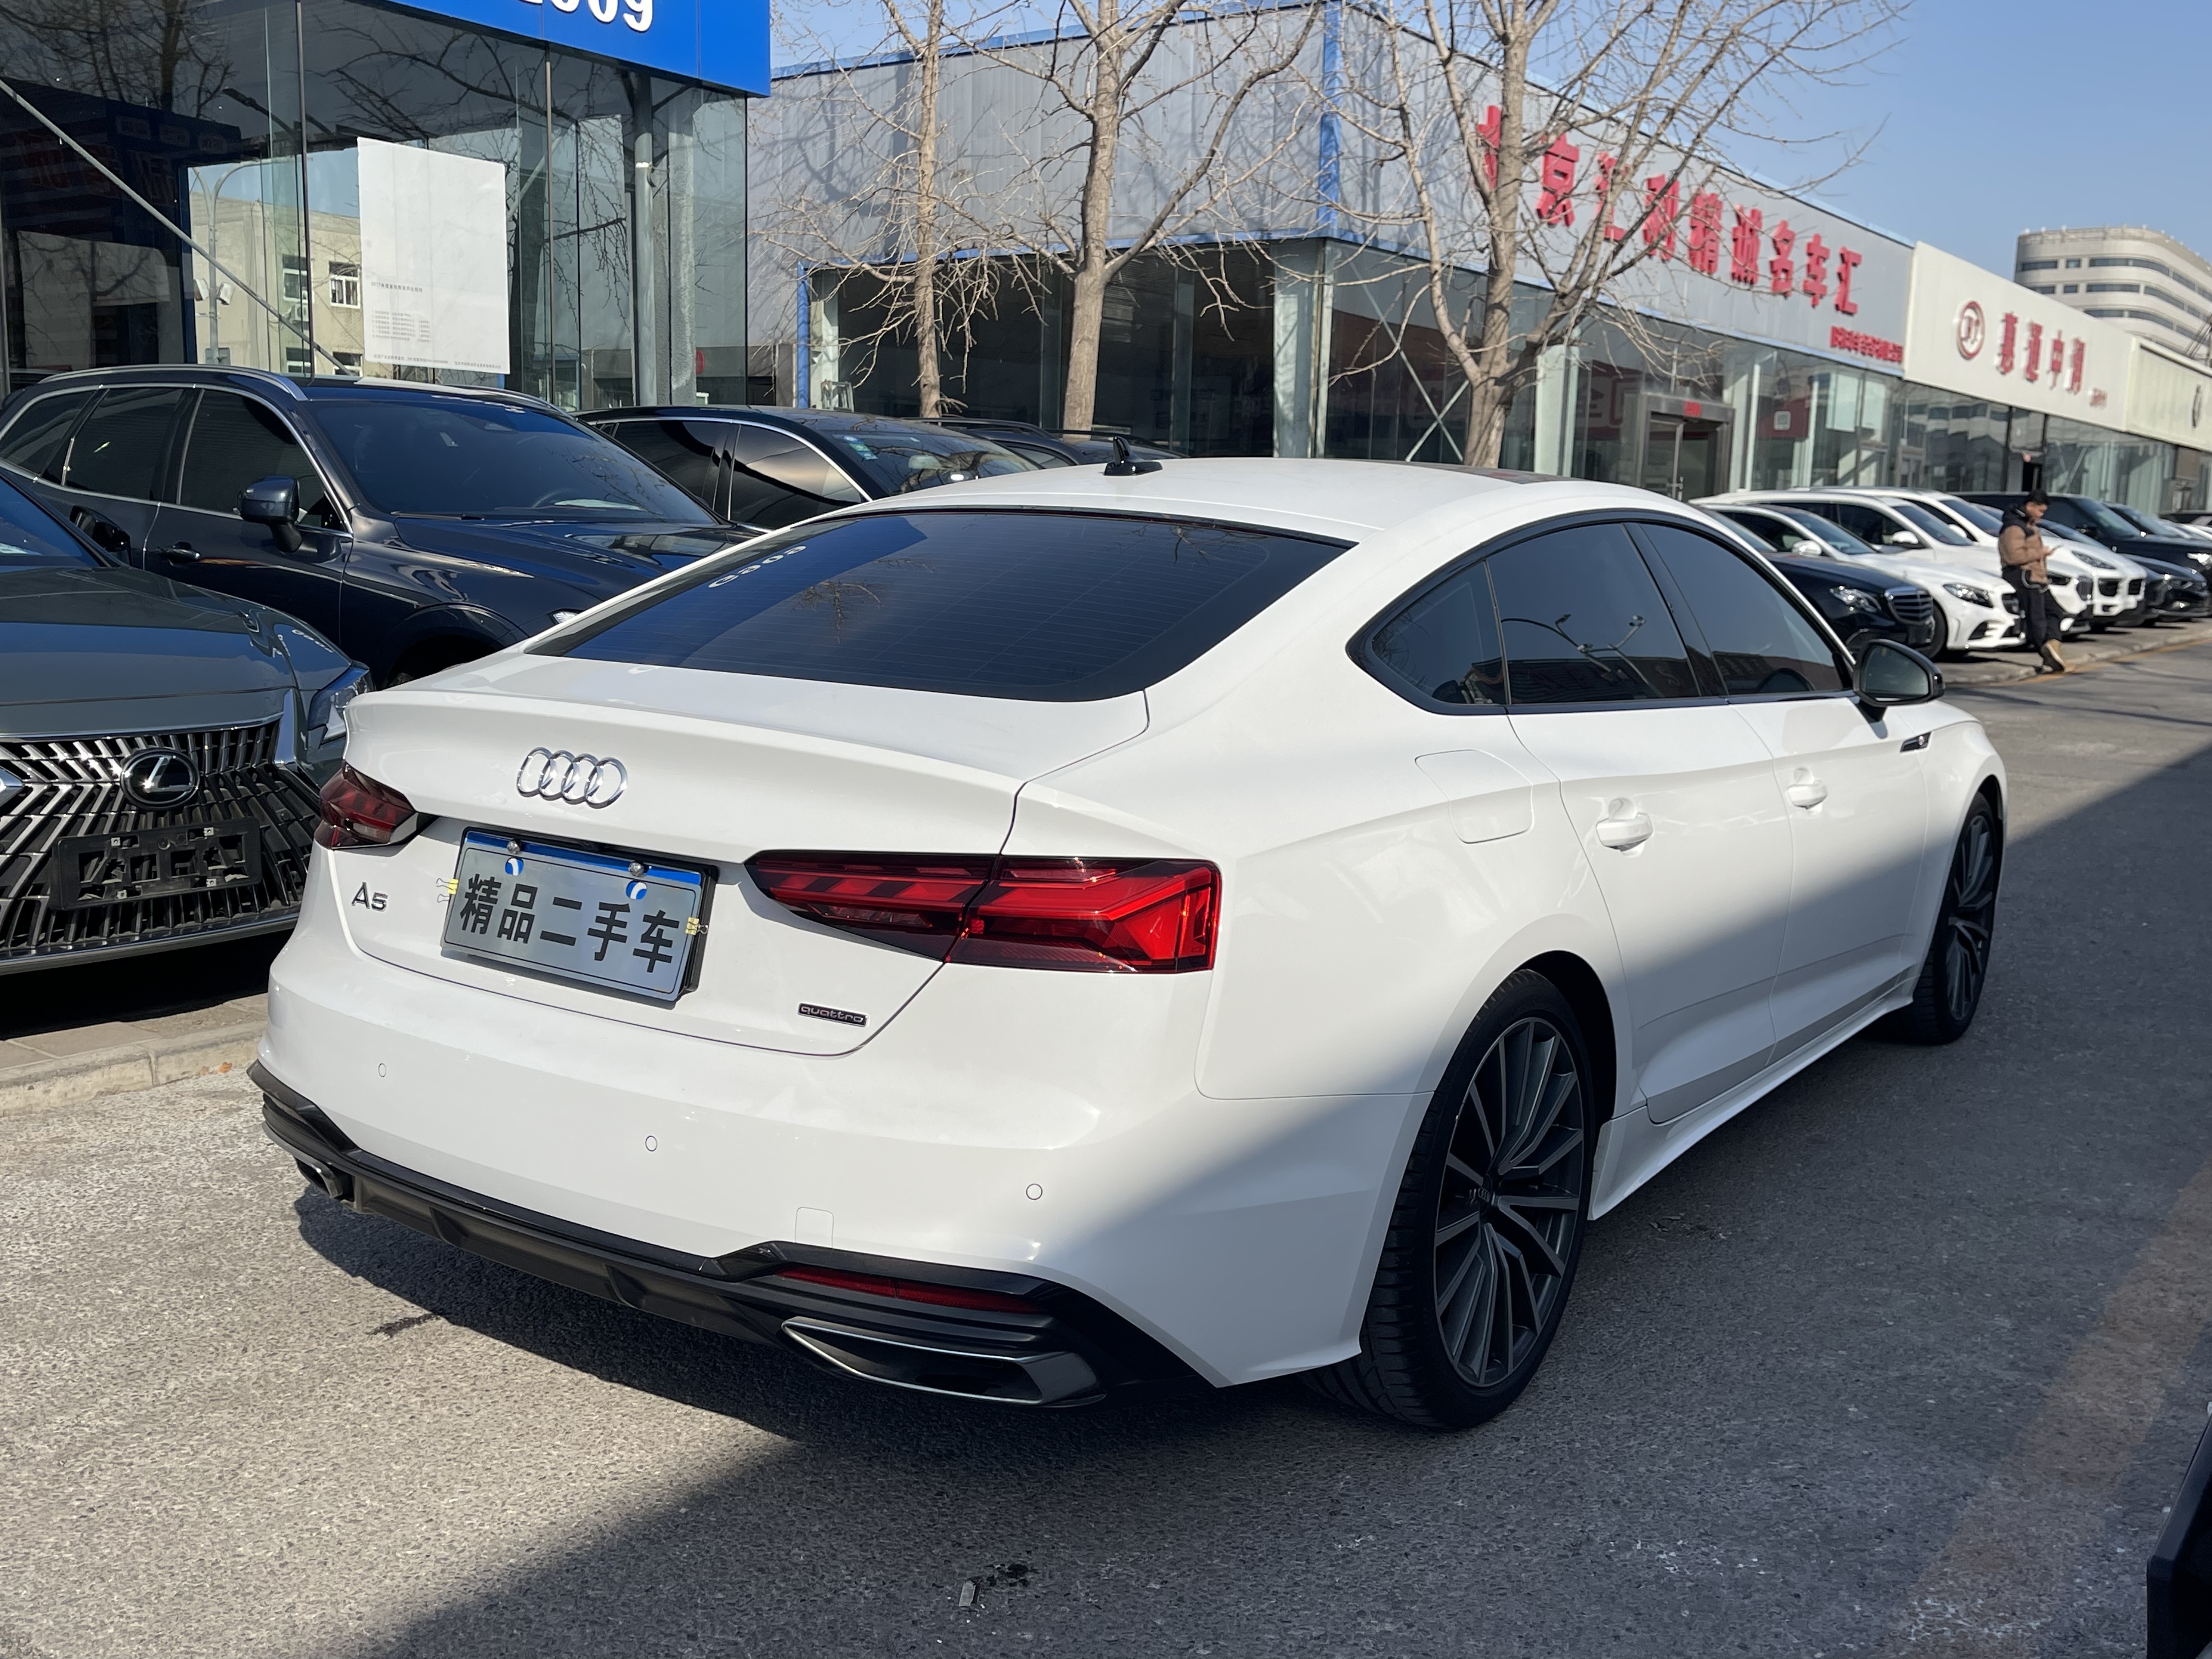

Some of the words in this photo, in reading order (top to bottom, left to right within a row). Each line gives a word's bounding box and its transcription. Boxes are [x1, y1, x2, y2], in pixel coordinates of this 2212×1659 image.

[351, 882, 388, 912] A5
[460, 873, 680, 973] 精品二手车
[800, 1005, 864, 1023] quattro
